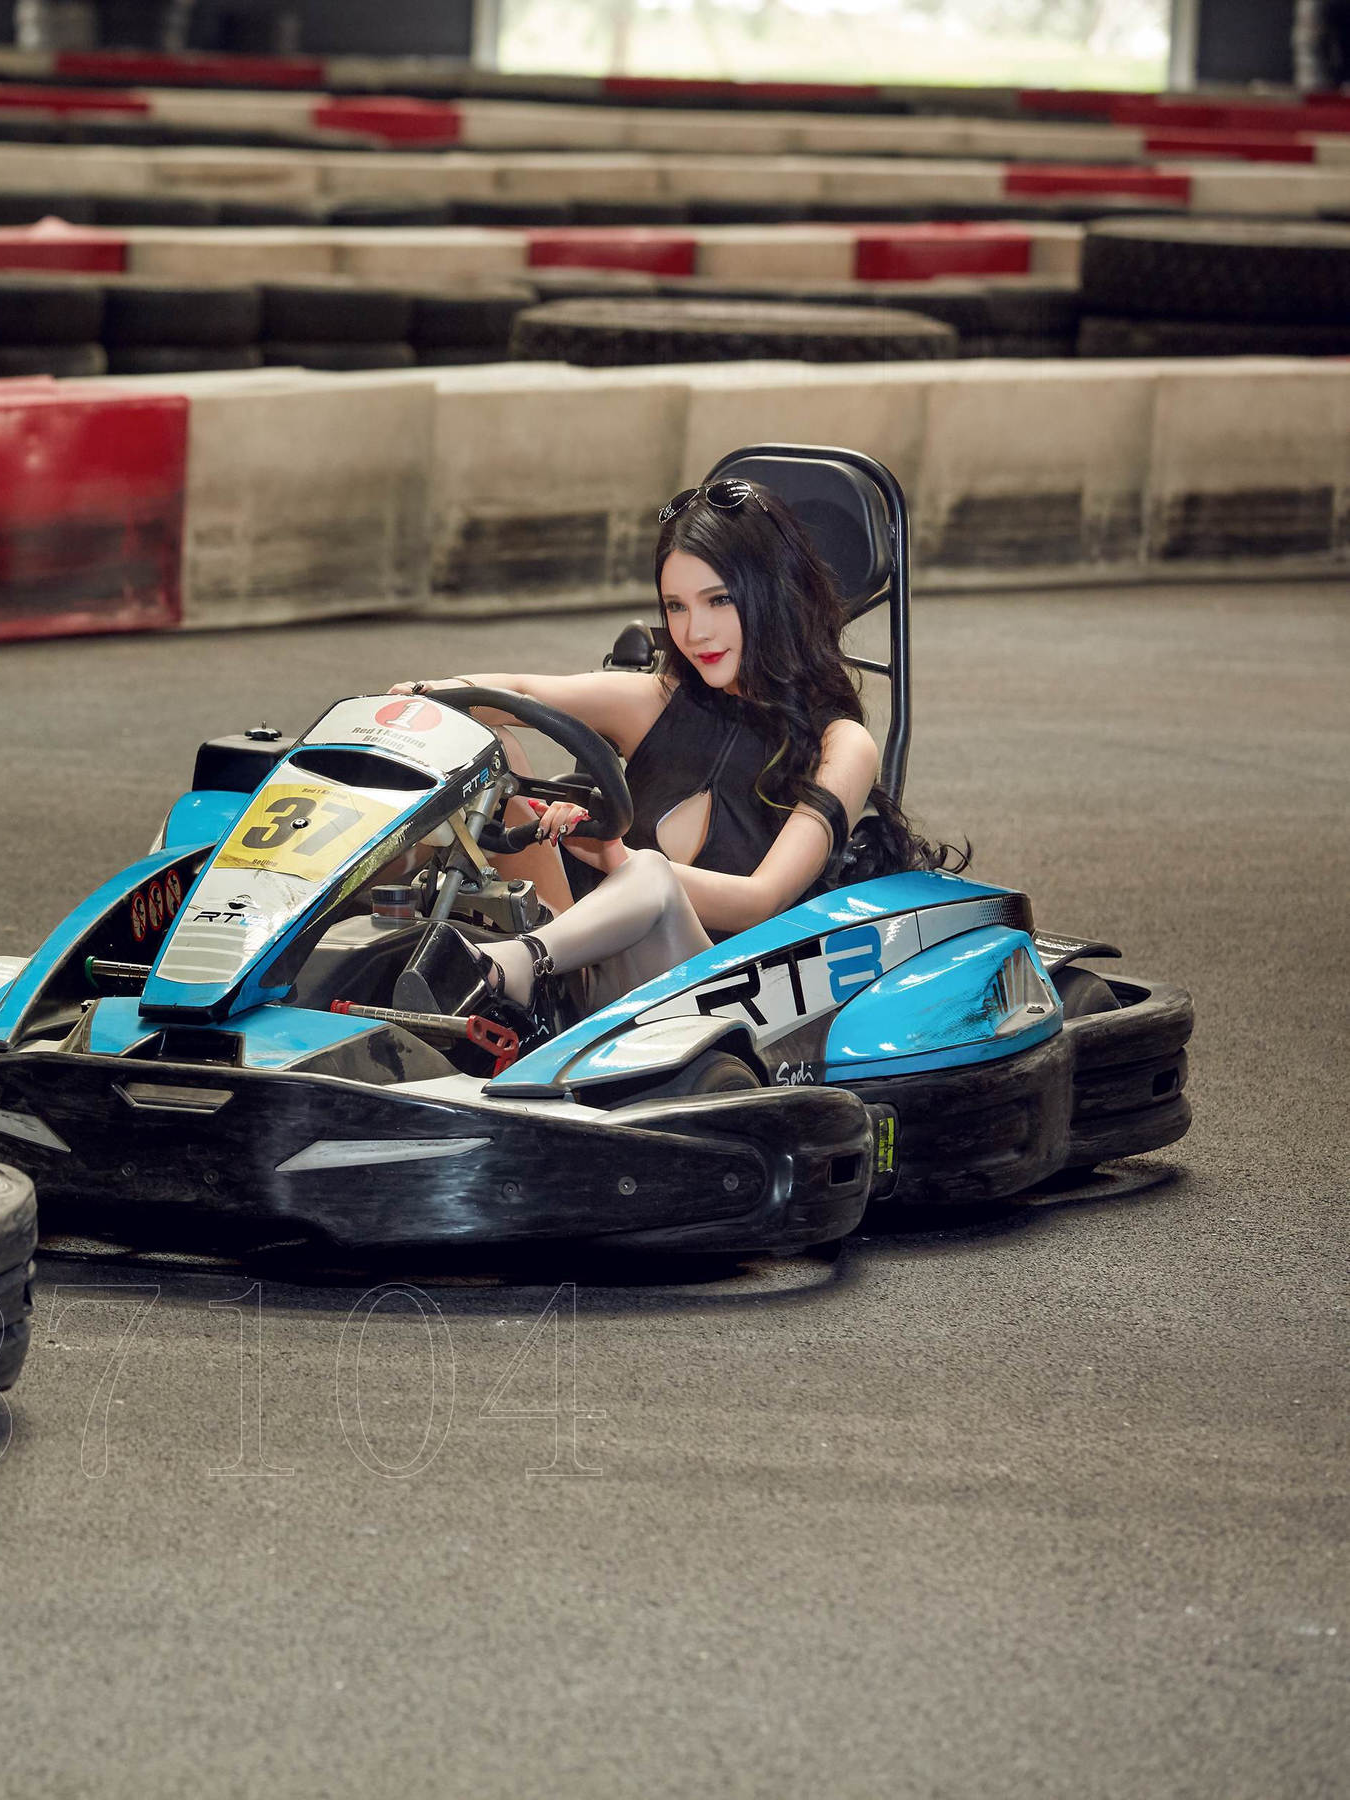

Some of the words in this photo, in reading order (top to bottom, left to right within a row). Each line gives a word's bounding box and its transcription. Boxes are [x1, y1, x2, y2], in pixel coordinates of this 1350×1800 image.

[351, 726, 376, 735] Red
[241, 796, 366, 857] 37
[695, 925, 884, 1027] RT8
[775, 1060, 815, 1088] Sodi
